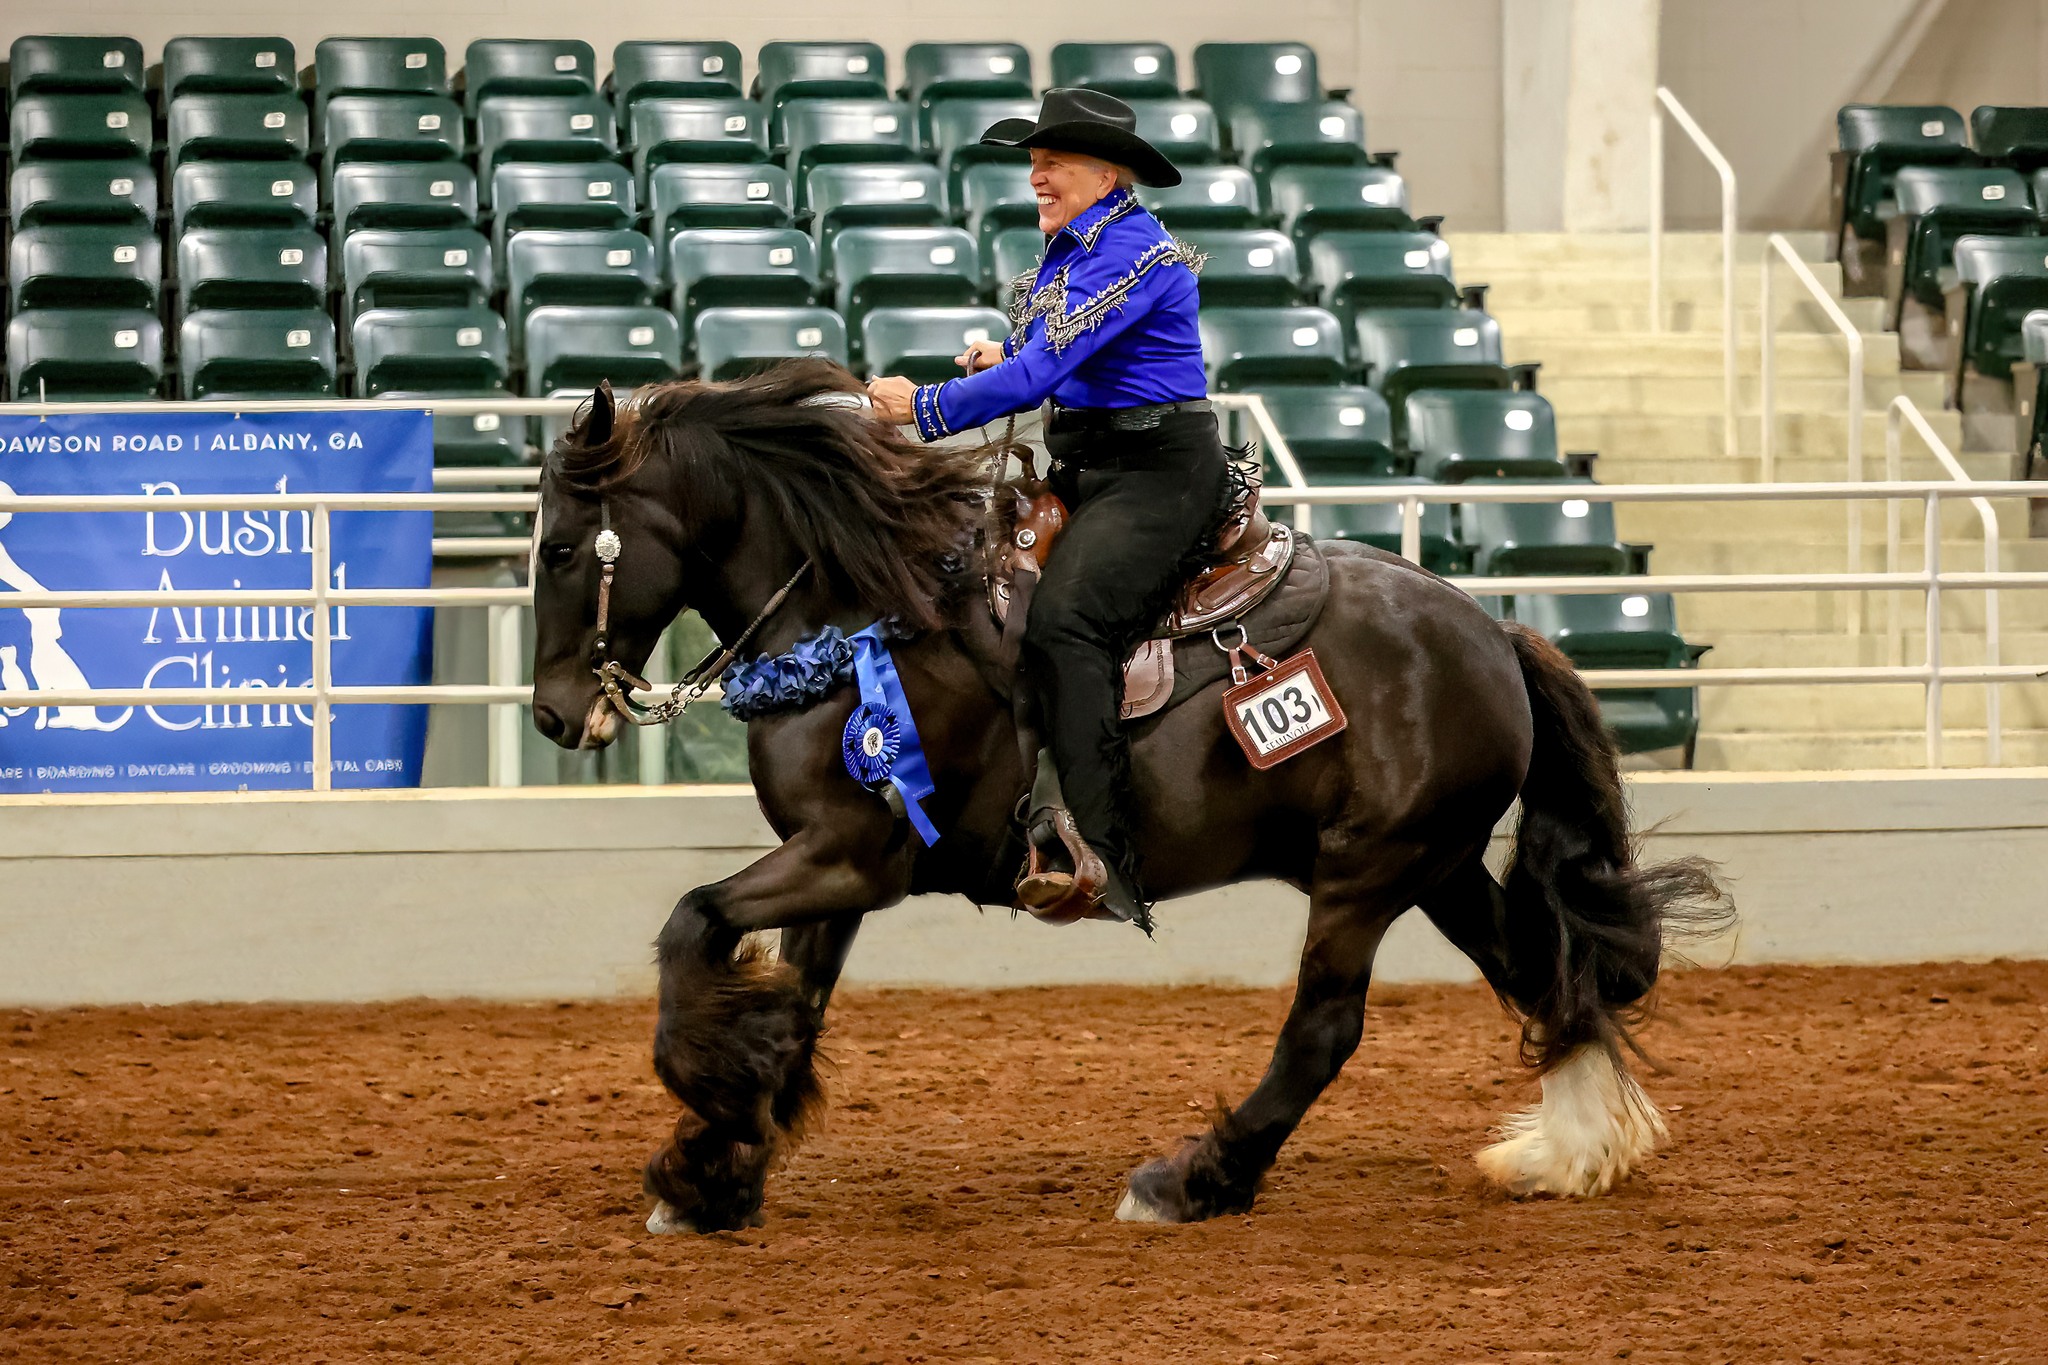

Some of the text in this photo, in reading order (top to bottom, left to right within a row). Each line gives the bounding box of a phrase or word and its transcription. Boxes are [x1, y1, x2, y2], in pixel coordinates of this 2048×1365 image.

[112, 434, 183, 452] ROAD
[210, 433, 317, 452] ALBANY,
[328, 431, 363, 450] GA
[141, 474, 314, 557] Bush
[142, 650, 336, 731] Clinic
[1242, 686, 1312, 744] 103
[37, 764, 115, 779] BOARDING
[127, 762, 196, 777] DAYCARE
[208, 760, 292, 775] GROOMING
[303, 760, 360, 773] DTAL
[364, 759, 404, 773] CARE
